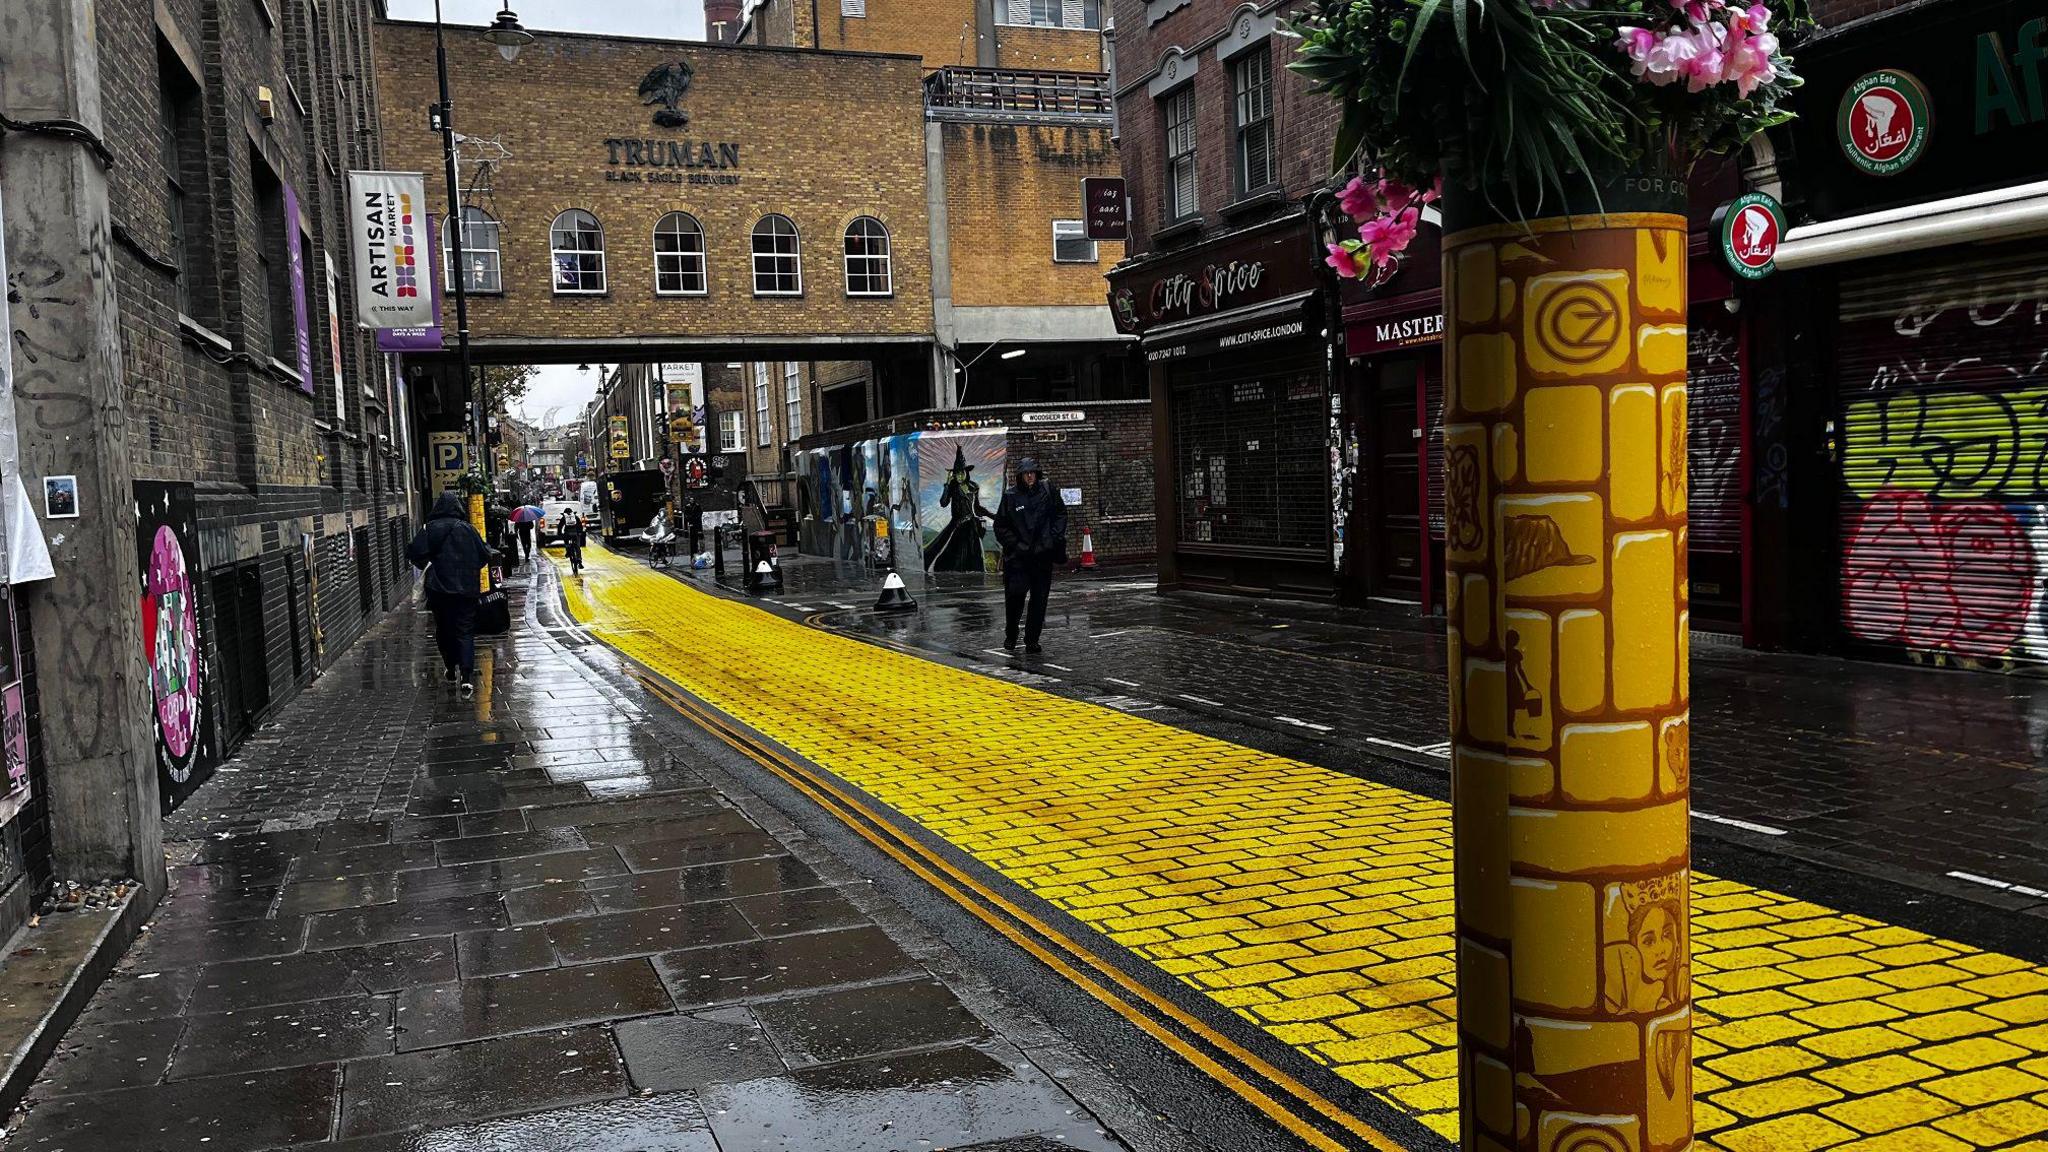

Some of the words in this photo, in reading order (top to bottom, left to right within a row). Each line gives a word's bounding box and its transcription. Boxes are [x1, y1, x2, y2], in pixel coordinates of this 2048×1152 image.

[1853, 76, 1878, 94] Afghan
[1880, 74, 1897, 84] Eats
[604, 139, 739, 168] TRUMAN
[1846, 142, 1872, 169] Authentic
[1874, 162, 1899, 173] Afghan
[1900, 127, 1924, 165] Restaurant
[606, 171, 641, 183] BLACK
[647, 173, 682, 184] EAGLE
[688, 174, 740, 185] BREWERY
[1624, 178, 1664, 192] FOR
[1740, 194, 1760, 205] Afghan
[1761, 194, 1773, 207] Eats
[387, 193, 397, 237] MARKET
[365, 192, 389, 298] ARTISAN
[1742, 266, 1761, 278] Afghan
[1152, 273, 1196, 319] City
[1200, 261, 1265, 309] Spice
[1220, 321, 1303, 347] WWW.CITY-SPICE.LONDON
[1148, 351, 1159, 361] 020
[439, 445, 457, 468] P
